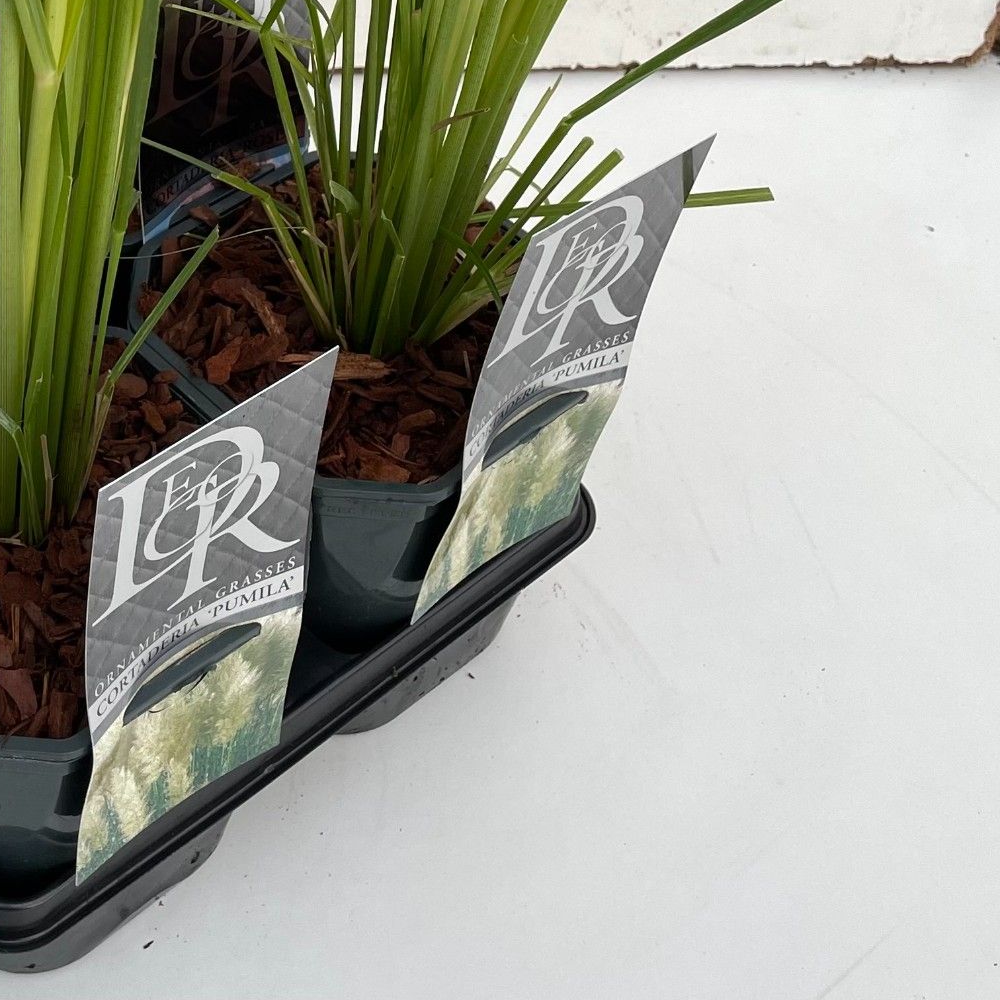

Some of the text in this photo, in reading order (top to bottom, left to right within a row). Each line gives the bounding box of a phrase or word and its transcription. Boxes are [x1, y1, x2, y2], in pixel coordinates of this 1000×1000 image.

[562, 331, 630, 364] GRASSES
[94, 556, 296, 698] ORNAMENTAL GRASSES
[96, 617, 200, 719] CORTADERIA
